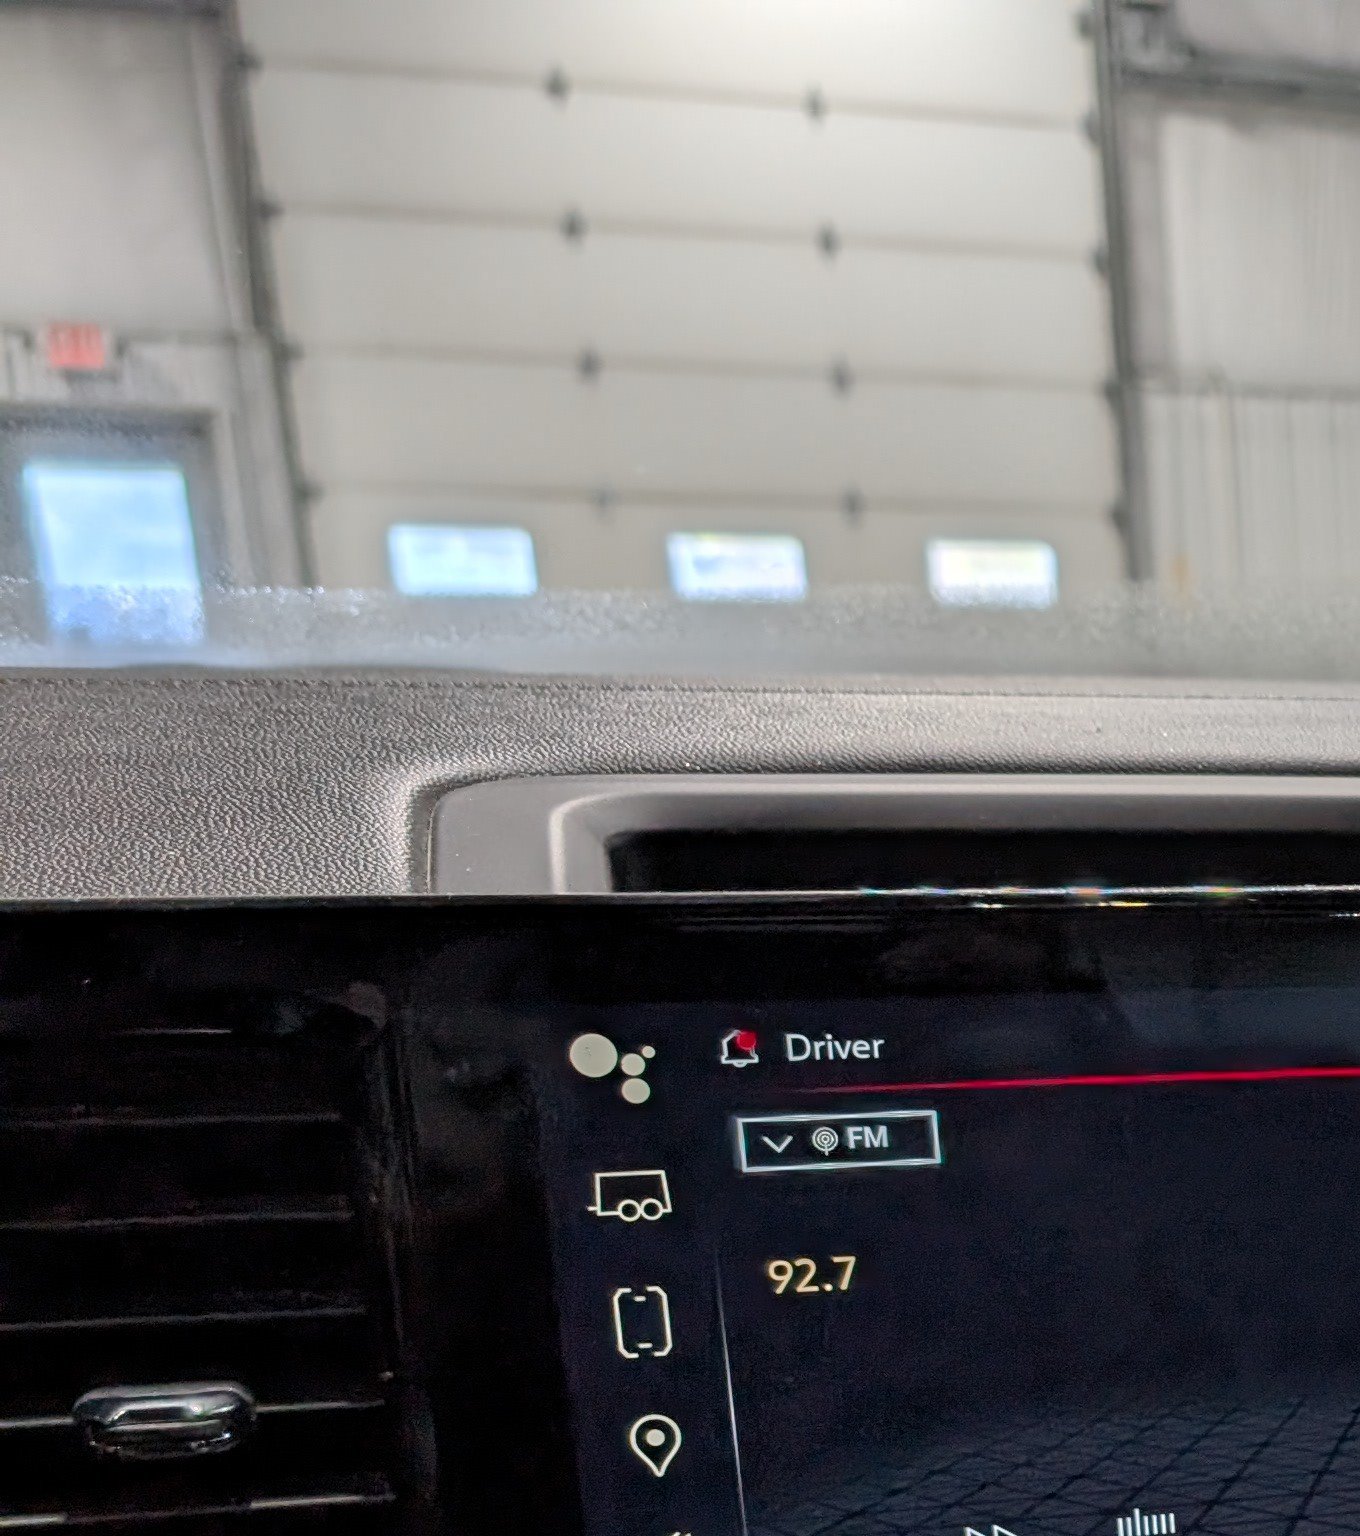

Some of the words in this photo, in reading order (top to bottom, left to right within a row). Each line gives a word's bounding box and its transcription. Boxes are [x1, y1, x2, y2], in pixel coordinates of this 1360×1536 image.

[785, 1033, 885, 1062] Driver
[846, 1125, 889, 1149] FM
[768, 1255, 856, 1295] 92.7
